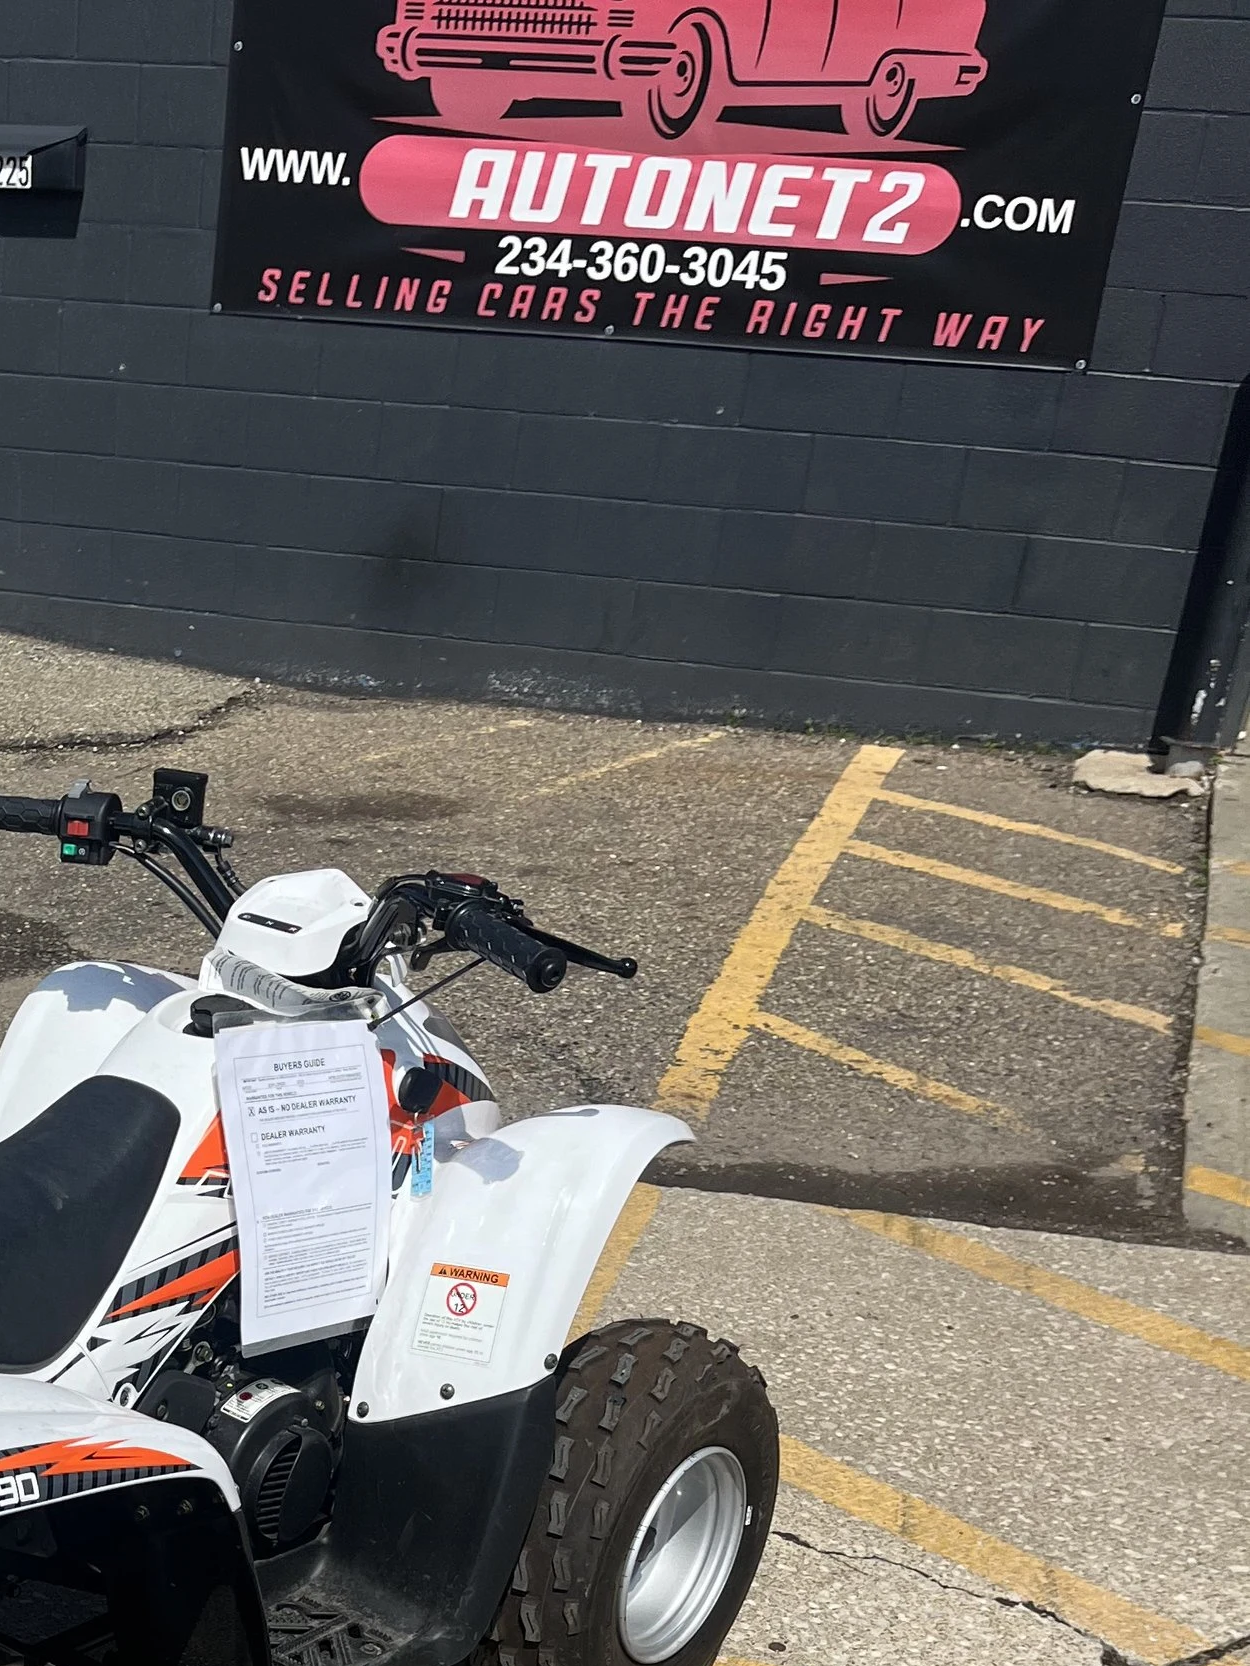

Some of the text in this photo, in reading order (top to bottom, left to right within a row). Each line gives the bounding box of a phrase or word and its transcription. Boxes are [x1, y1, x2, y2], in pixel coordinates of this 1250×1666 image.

[241, 147, 1076, 244] WWW. AUTONET2 .COM
[495, 236, 788, 291] 234-360-3045
[258, 269, 1044, 352] SELLING CARS THE RIGHT WAY
[273, 1057, 326, 1072] BUYERS GUIDE
[258, 1106, 267, 1114] AS
[268, 1105, 275, 1113] IS
[280, 1103, 291, 1112] NO
[292, 1100, 318, 1111] DEALER
[318, 1095, 356, 1107] WARRANTY
[261, 1125, 326, 1141] DEALER WARRANTY
[450, 1268, 499, 1284] WARNING
[454, 1303, 467, 1314] 12
